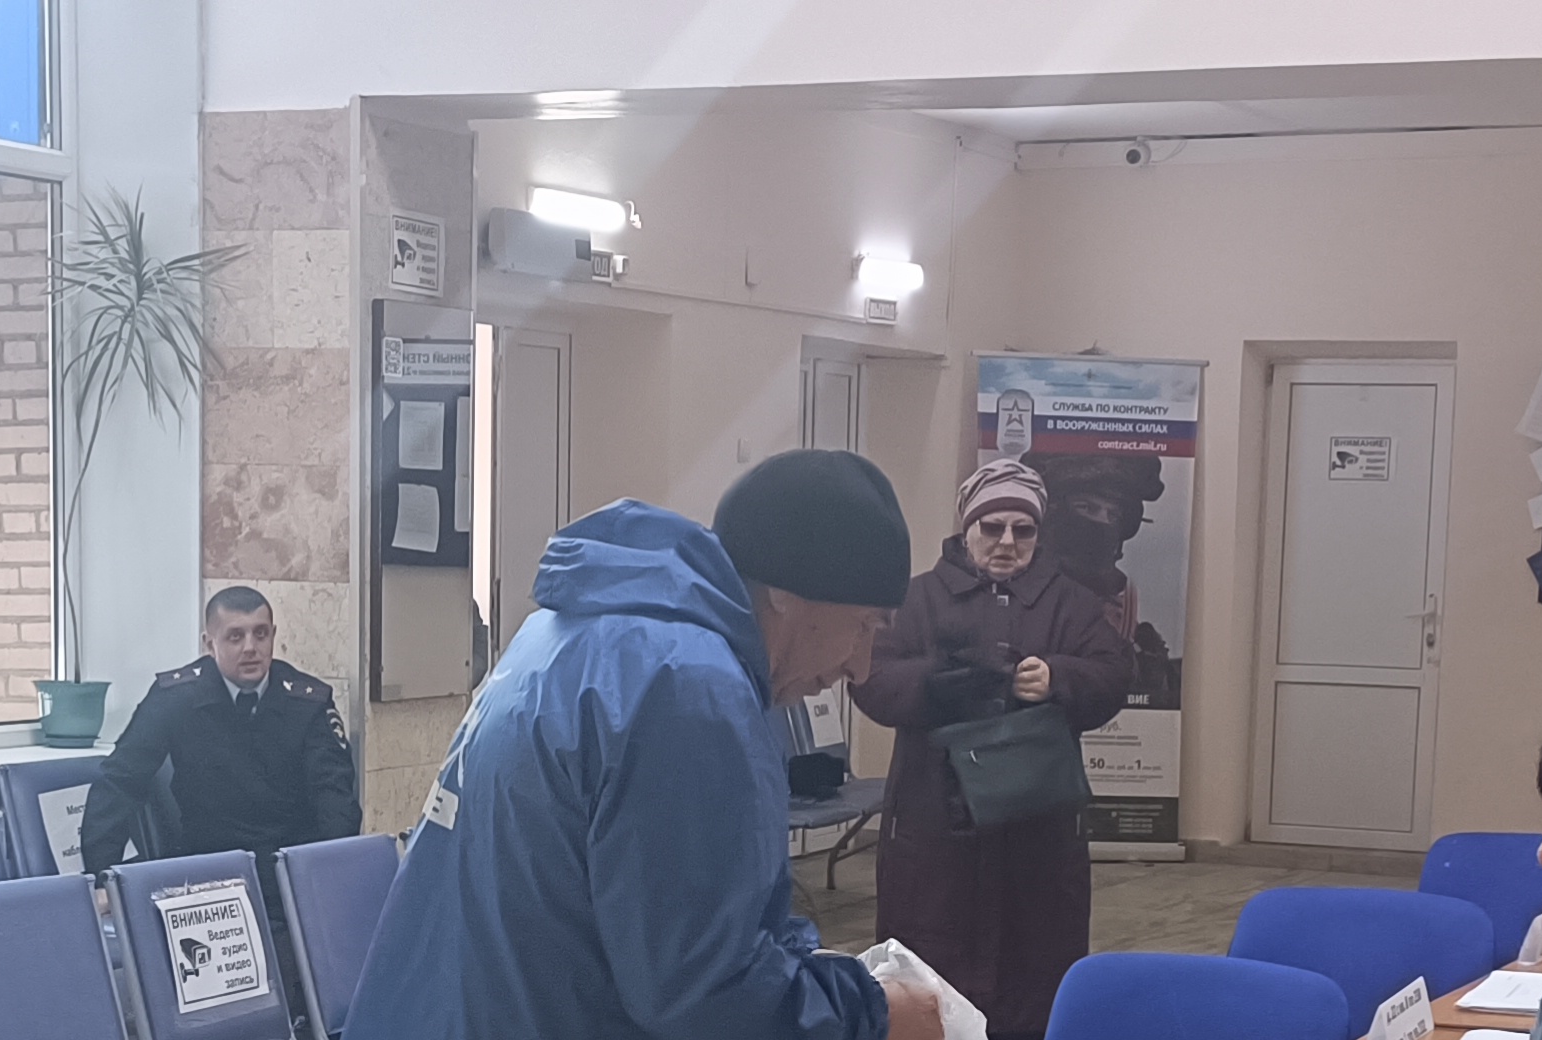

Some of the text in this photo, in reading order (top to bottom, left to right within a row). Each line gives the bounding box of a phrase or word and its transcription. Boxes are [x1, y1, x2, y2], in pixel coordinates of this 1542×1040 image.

[1052, 402, 1169, 415] СЛУЖБА ПО КОНТРАКТУ
[1047, 419, 1168, 433] В ВООРУЖЕННЫХ СИЛАХ
[1098, 440, 1167, 451] contract.mil.ru
[1089, 758, 1105, 769] 50
[171, 903, 241, 929] ВНИМАНИЕ!
[207, 927, 244, 941] Ведется
[221, 942, 248, 957] аудио
[217, 958, 252, 973] и видео
[225, 975, 255, 989] запись
